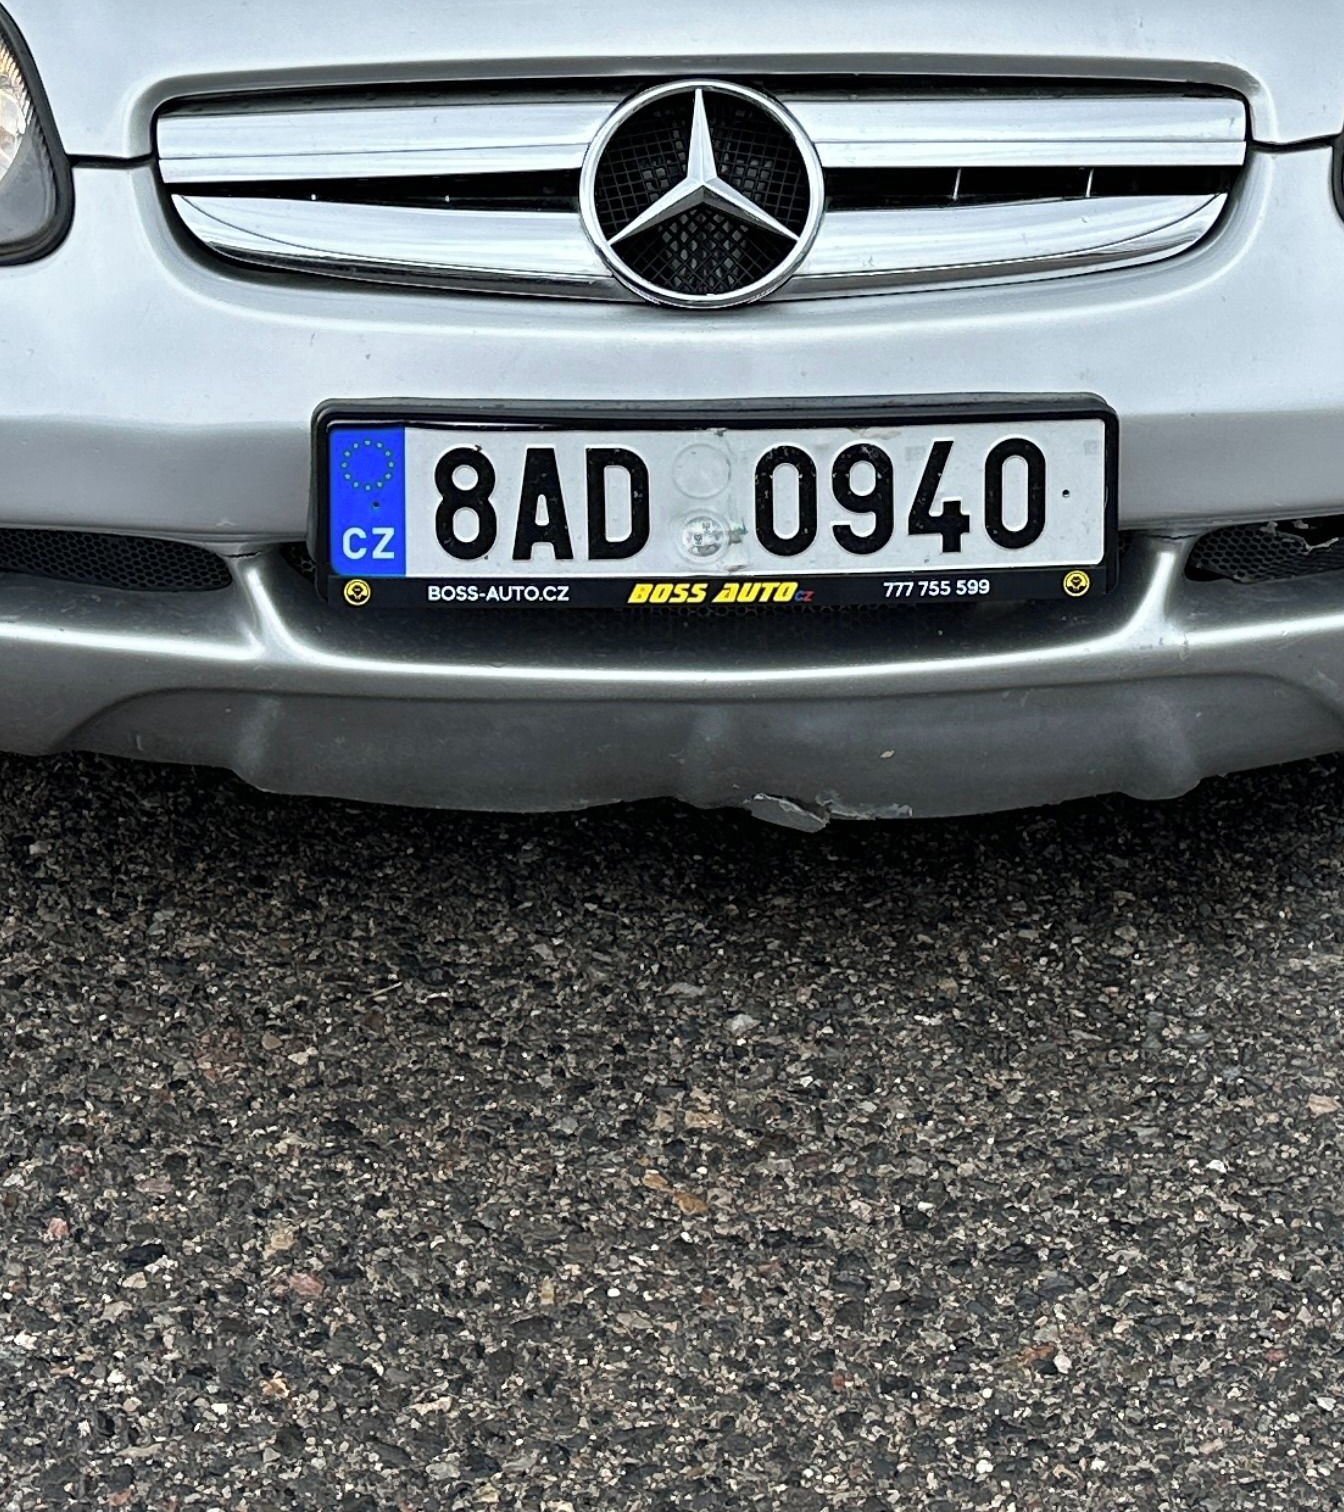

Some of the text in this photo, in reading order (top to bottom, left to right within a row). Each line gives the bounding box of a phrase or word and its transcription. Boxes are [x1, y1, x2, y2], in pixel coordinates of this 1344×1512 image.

[342, 437, 1046, 560] CZ 8AD 0940
[427, 585, 569, 603] BOSS-AUTO.CZ
[627, 583, 708, 604] BOSS
[711, 582, 798, 604] AUTO
[883, 578, 990, 598] 777 755 599
